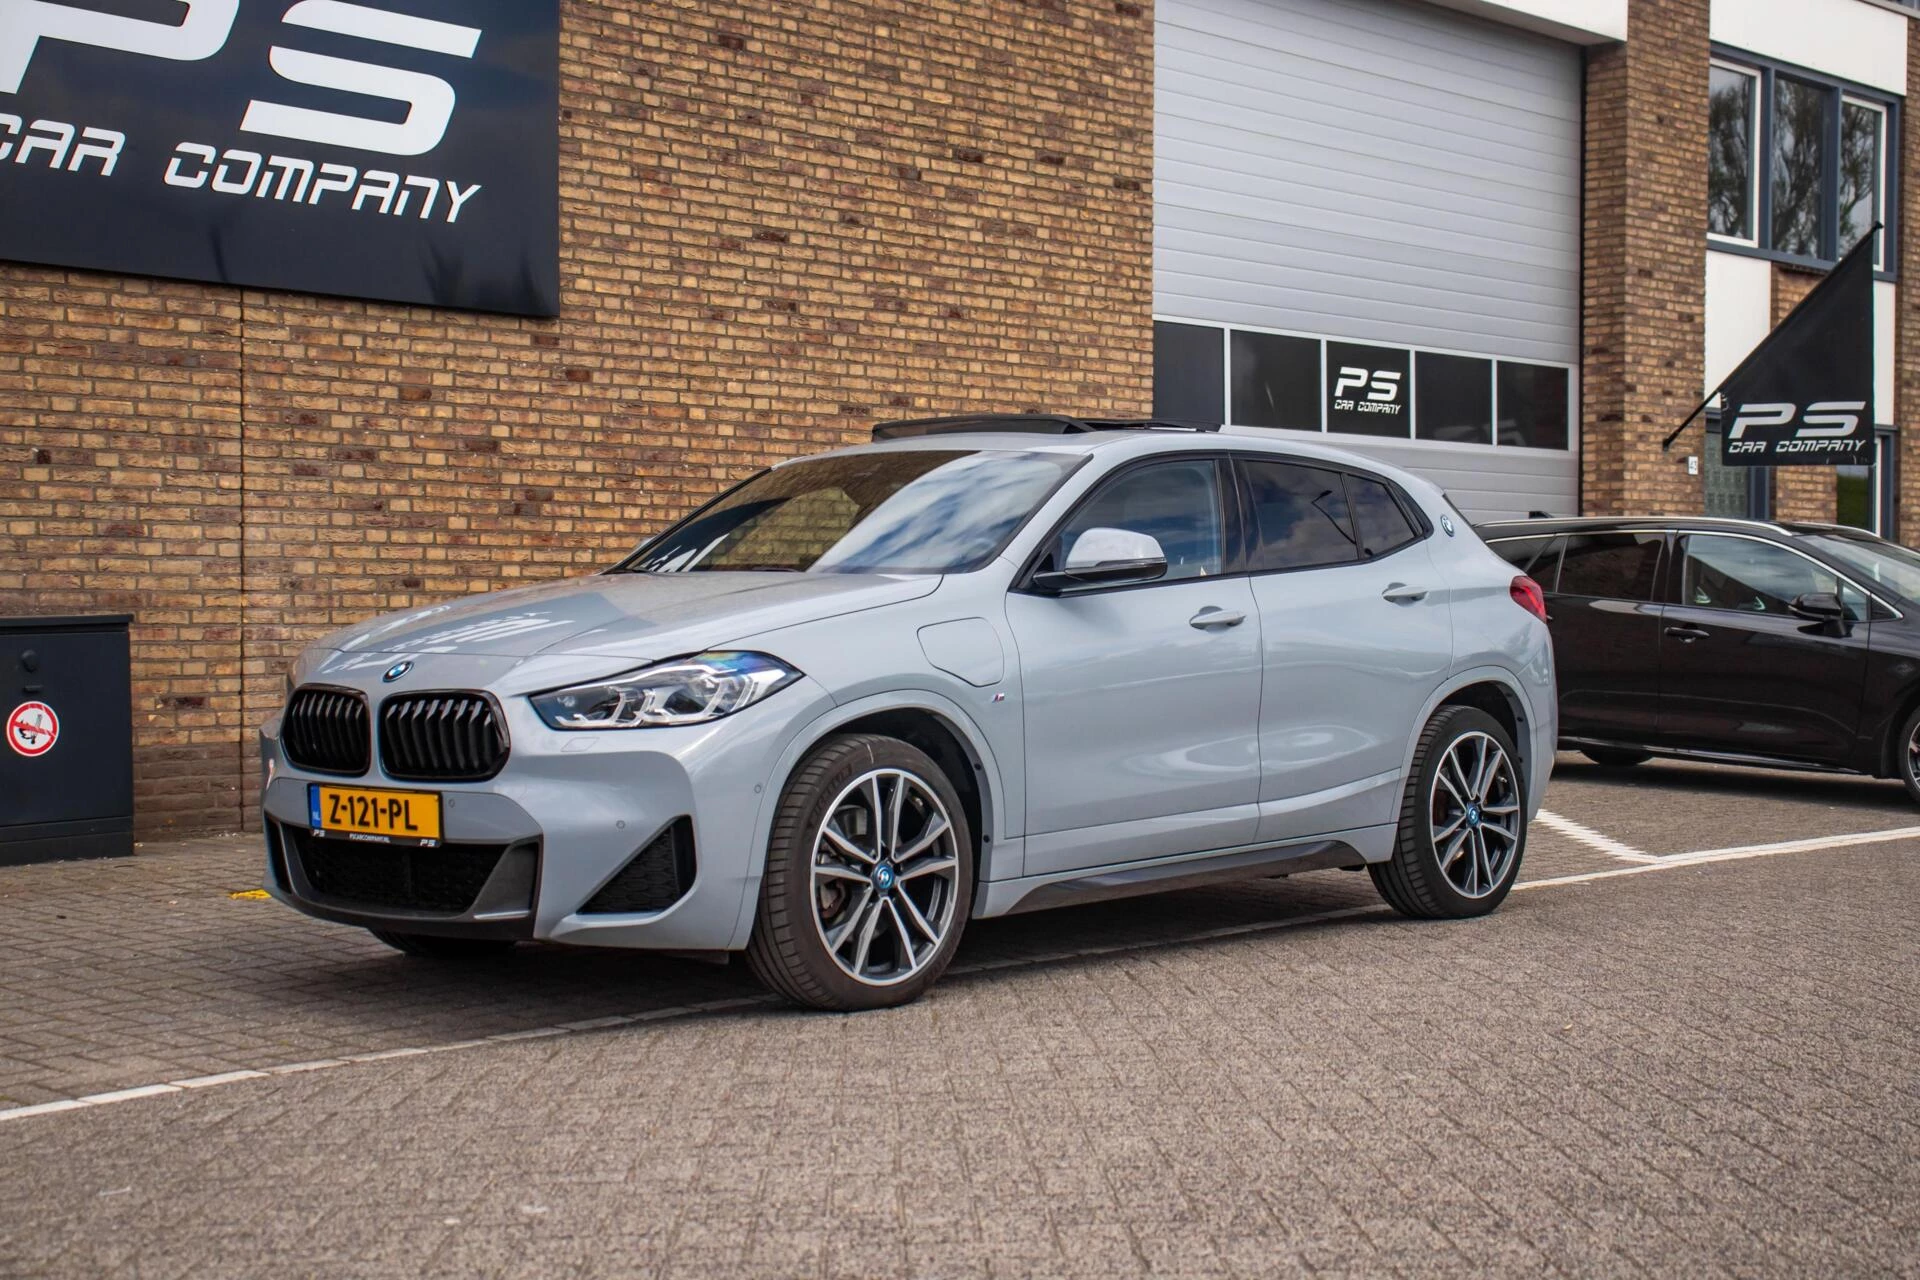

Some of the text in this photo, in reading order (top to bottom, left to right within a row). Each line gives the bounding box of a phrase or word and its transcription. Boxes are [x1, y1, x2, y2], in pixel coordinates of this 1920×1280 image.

[163, 141, 482, 223] COMPANY
[1334, 366, 1401, 401] PS
[1334, 399, 1401, 415] CAR COMPANY
[1728, 401, 1866, 439] PS
[1728, 439, 1866, 453] CAR COMPANY
[328, 794, 418, 831] Z-121-PL
[313, 829, 325, 837] PS
[420, 838, 436, 847] PS
